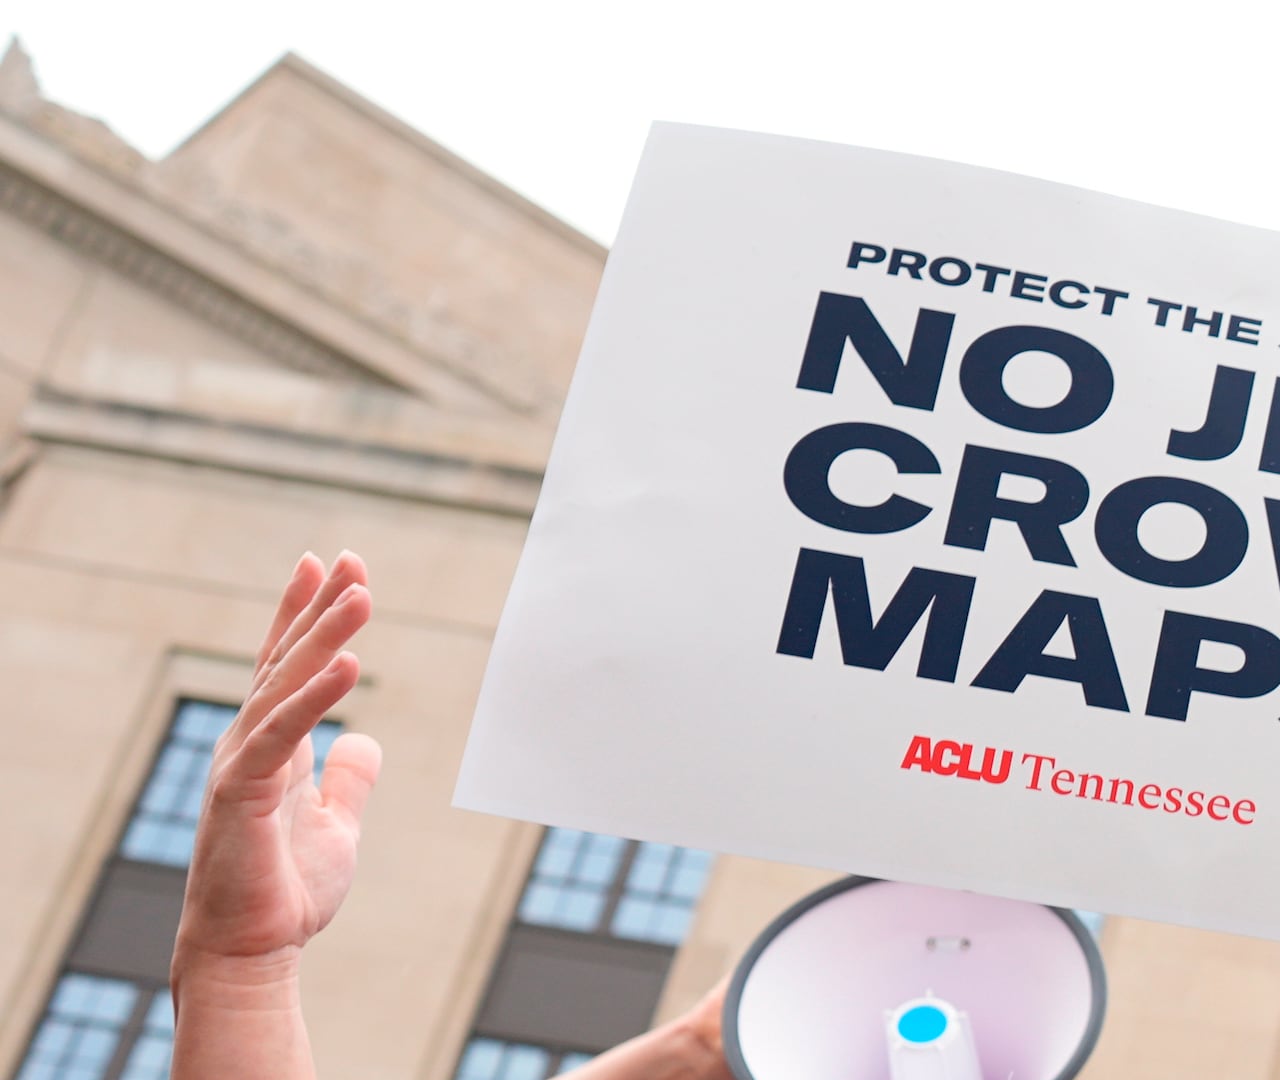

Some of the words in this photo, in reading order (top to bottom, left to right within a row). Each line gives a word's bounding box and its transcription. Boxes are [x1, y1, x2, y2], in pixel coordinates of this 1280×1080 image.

[847, 241, 1129, 316] PROTECT
[1147, 297, 1262, 346] THE
[795, 290, 1115, 435] NO
[901, 735, 1014, 785] ACLU
[1021, 752, 1257, 827] Tennessee
